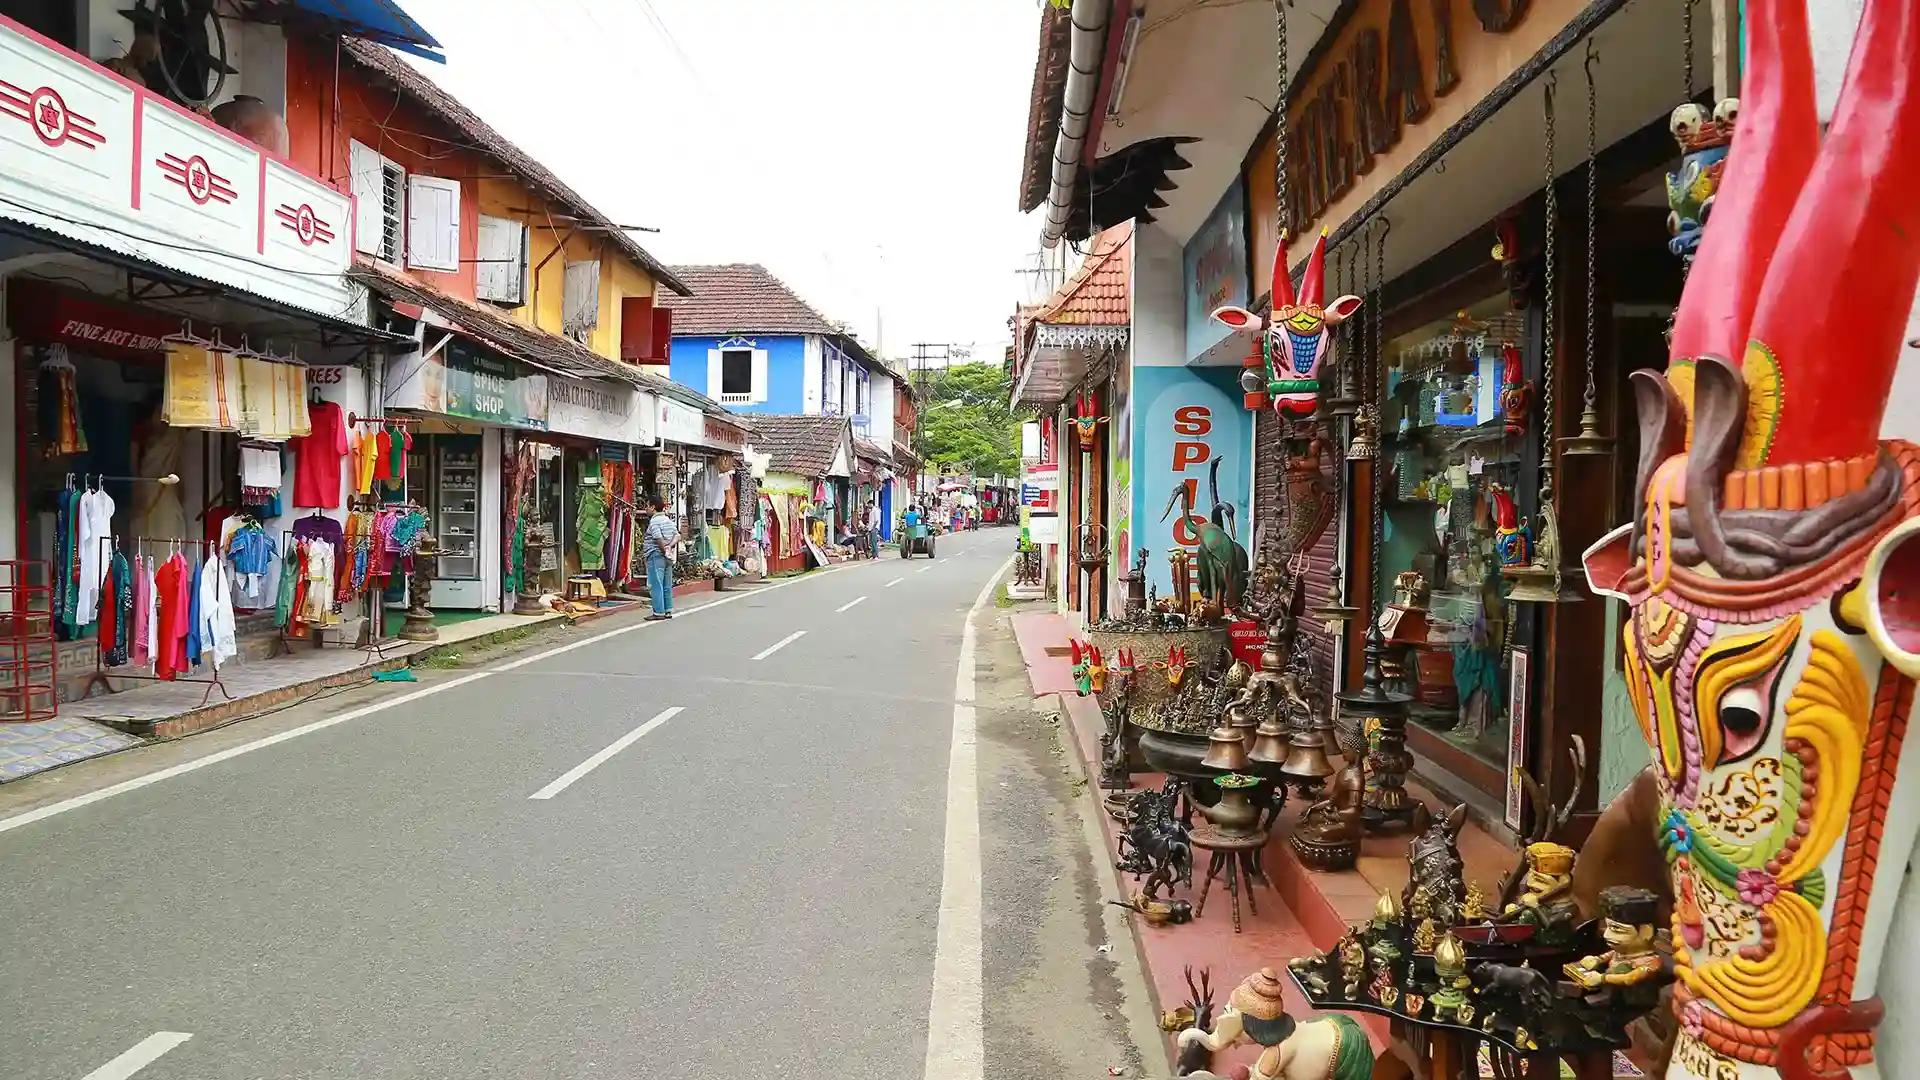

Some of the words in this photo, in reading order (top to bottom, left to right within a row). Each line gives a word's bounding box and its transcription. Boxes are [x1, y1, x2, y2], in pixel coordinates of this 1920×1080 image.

[60, 319, 103, 341] FINE
[98, 328, 131, 346] ART
[473, 371, 505, 393] SPICE
[475, 393, 504, 414] SHOP
